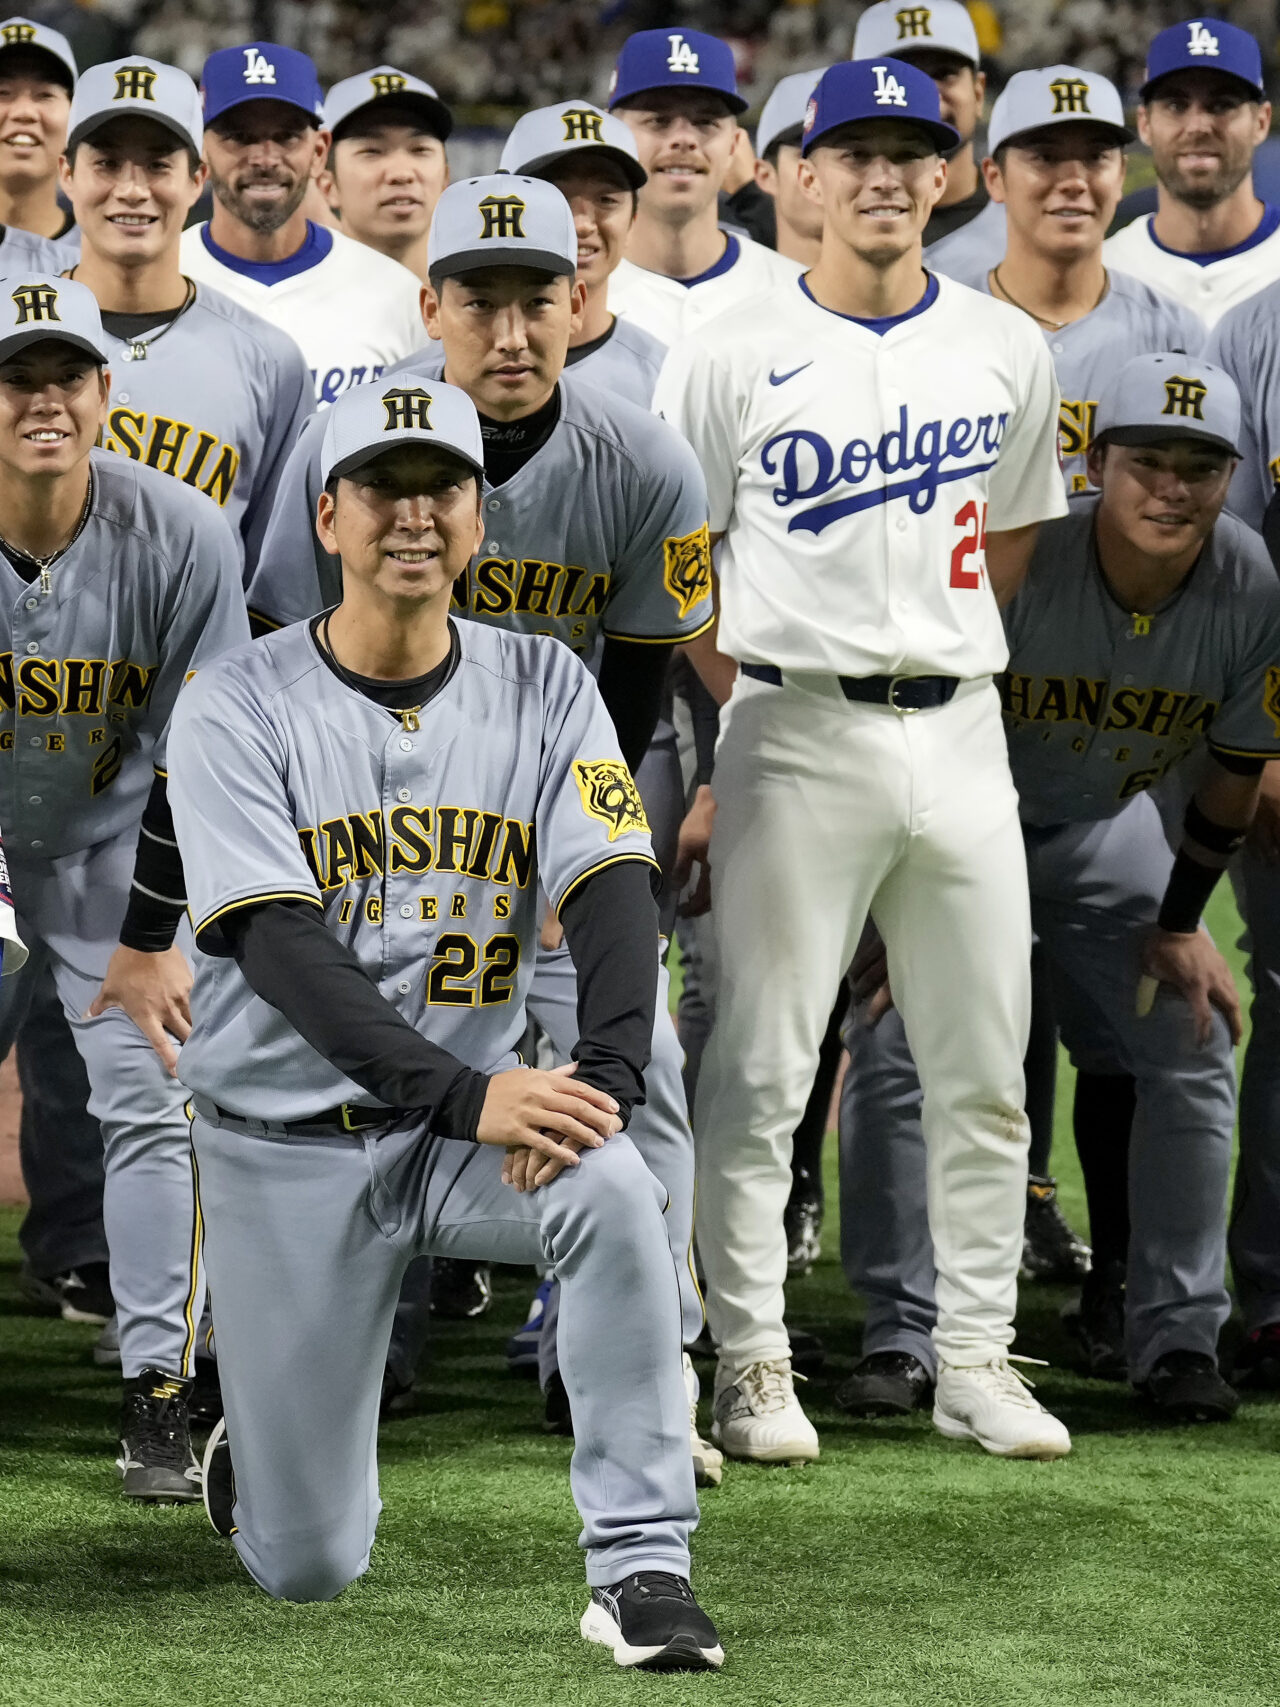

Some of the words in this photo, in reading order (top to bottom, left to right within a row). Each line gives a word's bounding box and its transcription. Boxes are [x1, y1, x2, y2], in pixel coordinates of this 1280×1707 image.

[667, 34, 700, 73] LA
[1187, 21, 1219, 56] LA
[243, 48, 276, 85] LA
[871, 66, 908, 107] LA
[761, 404, 1009, 515] Dodgers
[426, 932, 521, 1008] 22
